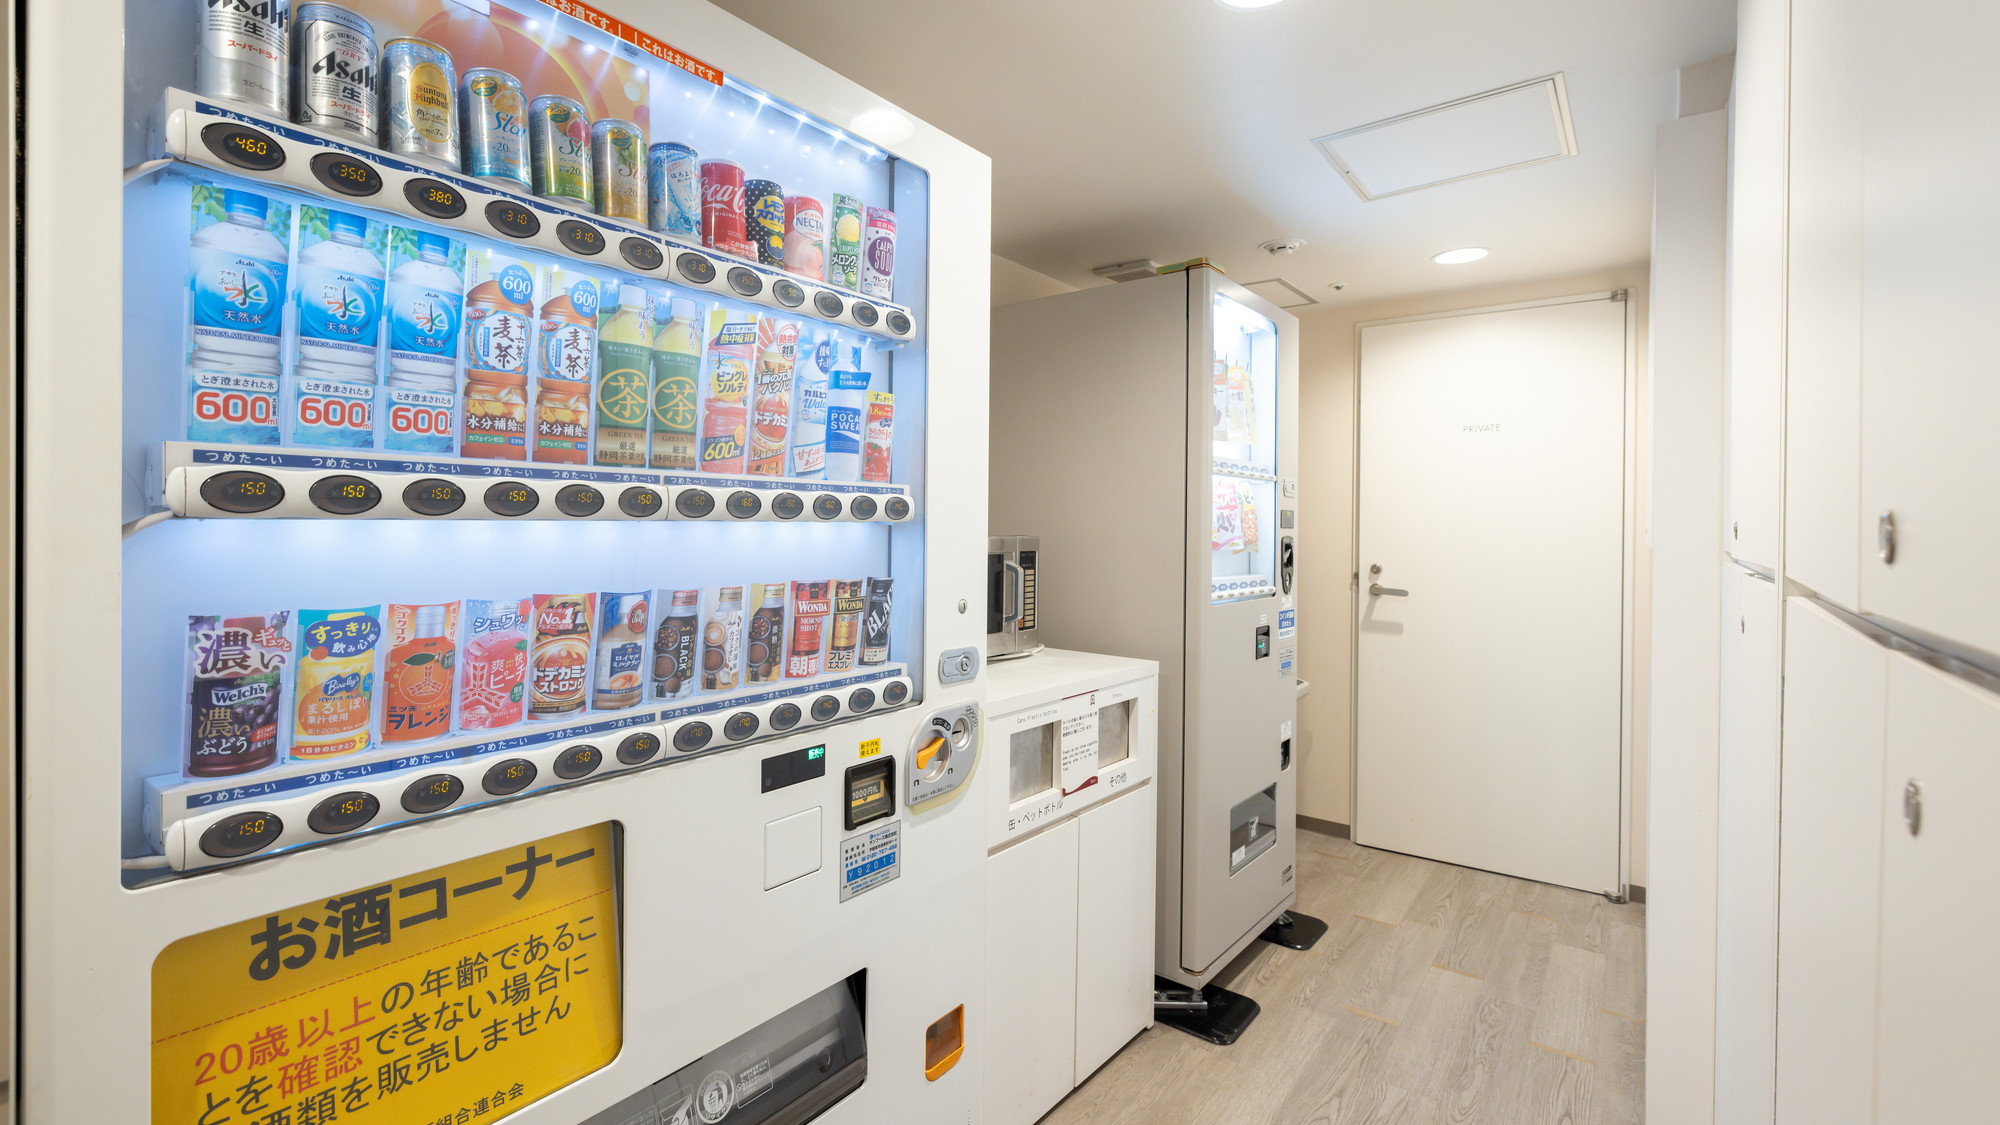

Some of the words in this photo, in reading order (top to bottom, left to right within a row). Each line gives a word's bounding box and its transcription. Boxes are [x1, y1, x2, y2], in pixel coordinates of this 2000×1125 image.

[244, 20, 264, 38] 生
[227, 39, 278, 61] スーパードライ
[641, 37, 719, 84] これはお酒です。
[312, 50, 379, 95] Asahi
[341, 86, 361, 104] 生
[330, 100, 371, 119] スーパードライ
[235, 137, 267, 155] 460
[340, 164, 366, 182] 350
[429, 189, 452, 205] 380
[507, 210, 528, 225] 310
[575, 229, 594, 243] 310
[235, 259, 255, 268] Asahi
[691, 260, 706, 273] 310
[502, 275, 531, 295] 600
[513, 290, 524, 300] ml
[574, 292, 596, 308] 600
[224, 309, 262, 324] 天然水
[326, 322, 360, 335] 天然水
[415, 335, 445, 348] 天然水
[492, 315, 517, 369] 麦茶
[565, 328, 584, 378] 麦茶
[201, 374, 275, 391] とぎ澄まされた水
[305, 382, 371, 398] とぎ澄まされた水
[396, 392, 452, 405] とぎ澄まされた水
[604, 376, 646, 421] 茶
[657, 383, 696, 426] 茶
[1463, 424, 1501, 432] PRIVATE
[468, 435, 504, 444] カフェインゼロ
[540, 440, 572, 448] カフェインゼロ
[619, 441, 636, 451] 厳選
[672, 445, 688, 455] 厳選
[206, 452, 283, 465] つめた〜い
[312, 456, 378, 469] つめた〜い
[402, 462, 461, 474] つめた〜い
[482, 466, 533, 478] つめた〜い
[552, 470, 598, 480] つめた〜い
[614, 474, 655, 484] つめた〜い
[240, 482, 266, 495] 150
[342, 485, 365, 498] 150
[431, 488, 451, 500] 150
[509, 491, 526, 502] 150
[577, 493, 593, 503] 150
[637, 494, 652, 505] 150
[798, 601, 828, 614] WONDA
[838, 598, 863, 611] WONDA
[539, 607, 574, 624] No.1
[254, 627, 291, 652] ギュッと
[311, 622, 371, 643] すっきり
[332, 635, 377, 654] 飲み心地
[198, 630, 286, 675] 濃い
[678, 635, 690, 671] BLACK
[490, 663, 526, 689] ピーチ
[533, 664, 586, 682] ドデカミン
[214, 684, 266, 703] Welch's
[539, 679, 584, 693] ストロング
[717, 697, 751, 709] つめた〜い
[307, 713, 349, 725] 果汁使用
[667, 705, 704, 718] つめた〜い
[198, 707, 251, 738] 濃い
[609, 715, 651, 728] つめた〜い
[547, 726, 593, 740] つめた〜い
[197, 736, 248, 755] ぶどう
[301, 742, 356, 754] 1日分のビタミン
[477, 737, 528, 753] つめた〜い
[636, 739, 650, 750] 150
[860, 747, 880, 757] 使えます
[397, 750, 456, 768] つめた〜い
[576, 752, 591, 763] 150
[306, 765, 372, 785] つめた〜い
[507, 766, 524, 778] 150
[1109, 771, 1128, 787] その他
[200, 784, 277, 805] つめた〜い
[429, 781, 449, 794] 150
[342, 800, 363, 814] 150
[1008, 799, 1064, 832] 缶・ペットボトル
[239, 819, 265, 835] 150
[247, 845, 596, 981] お酒コーナー
[194, 915, 598, 1086] 20歳以上の年齢であるこ
[198, 953, 589, 1125] とを確認できない場合に
